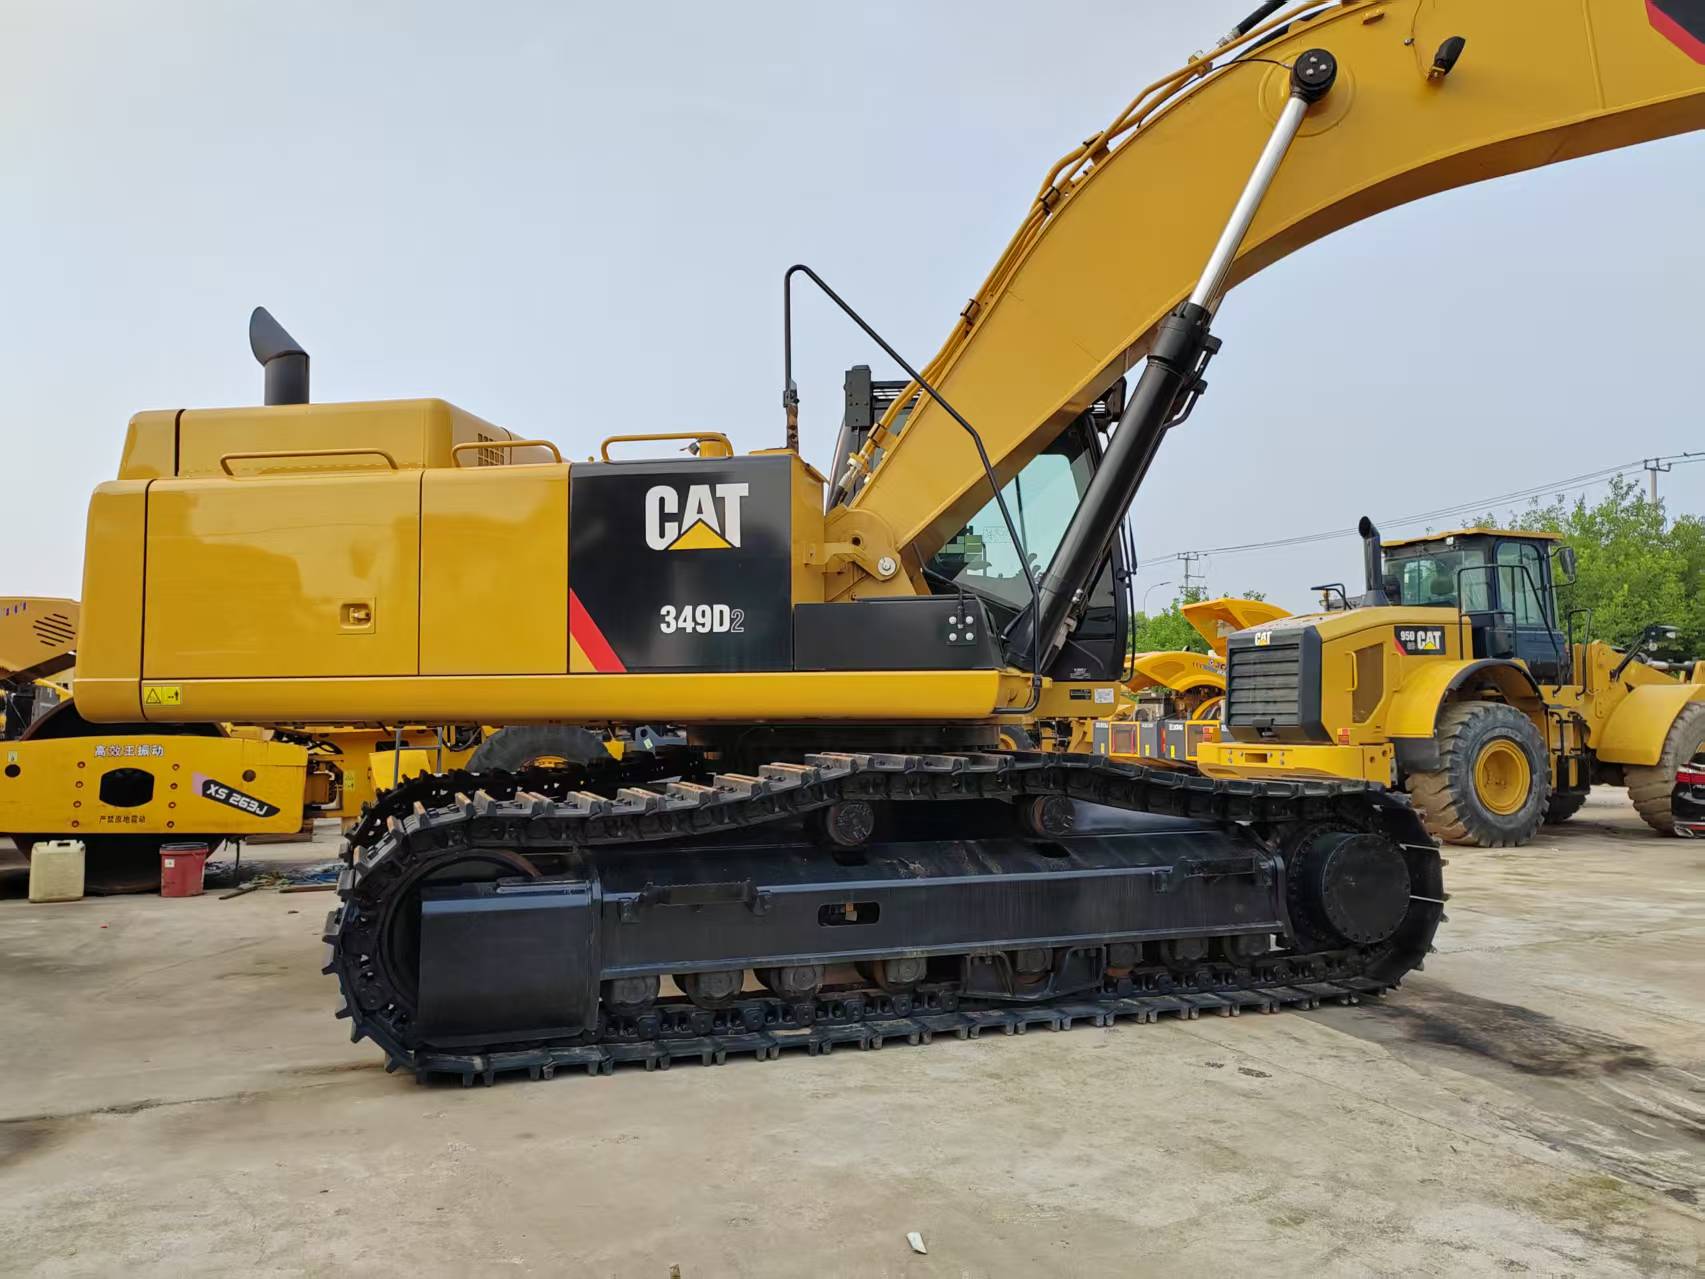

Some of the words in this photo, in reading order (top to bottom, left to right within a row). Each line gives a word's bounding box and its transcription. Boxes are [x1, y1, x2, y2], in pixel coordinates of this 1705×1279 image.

[645, 483, 749, 551] CAT
[660, 604, 744, 635] 349D2
[1255, 631, 1273, 646] CAT
[1400, 631, 1415, 641] 950
[1417, 631, 1441, 650] CAT
[206, 784, 229, 800] XS
[229, 793, 268, 815] 263J
